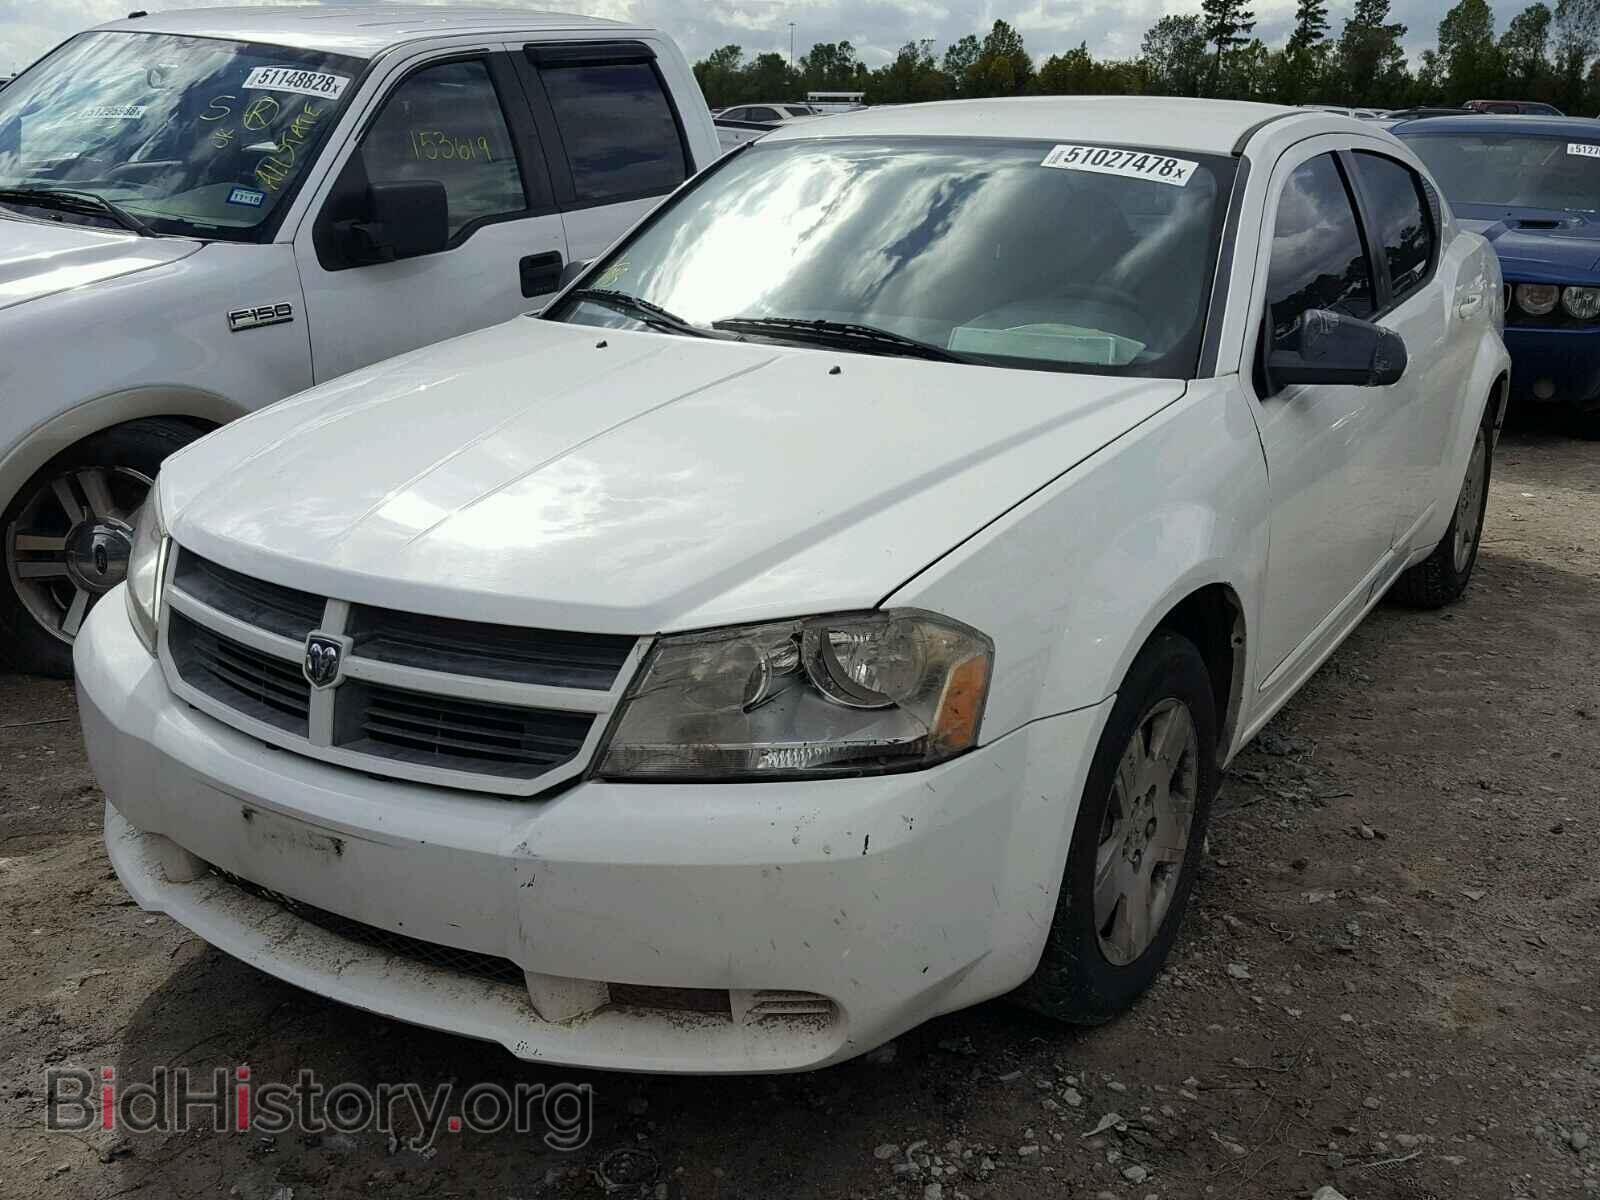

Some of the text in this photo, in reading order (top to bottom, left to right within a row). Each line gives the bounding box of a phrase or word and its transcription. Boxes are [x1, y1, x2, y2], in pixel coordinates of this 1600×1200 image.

[409, 129, 492, 161] 153619
[1575, 144, 1600, 156] 5127
[1063, 147, 1186, 179] 51027478x
